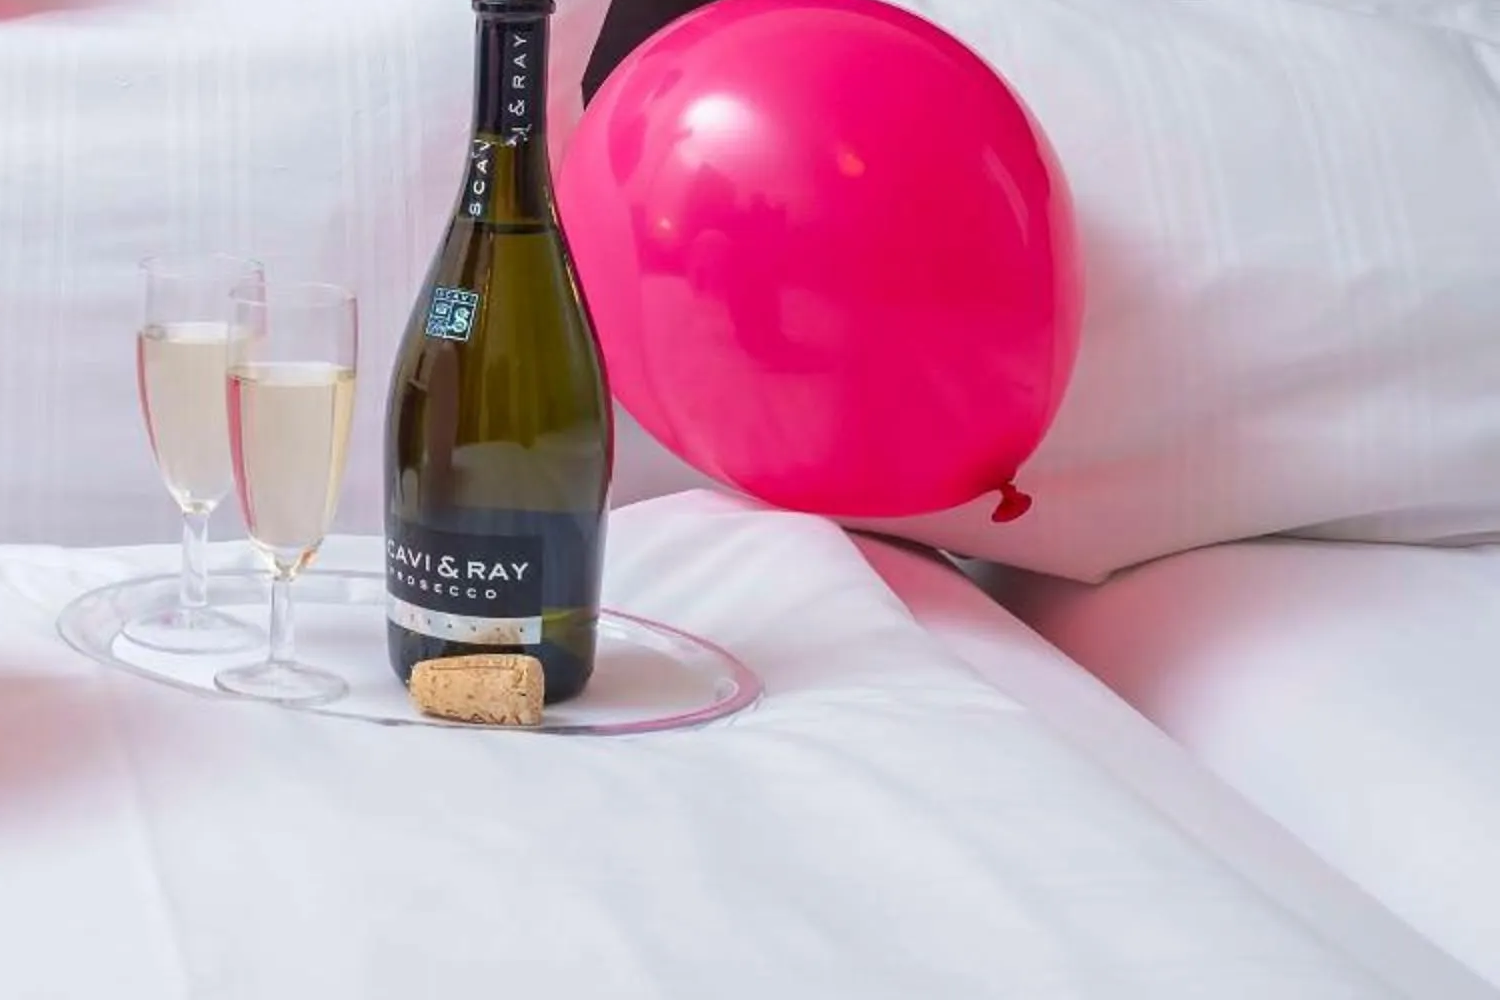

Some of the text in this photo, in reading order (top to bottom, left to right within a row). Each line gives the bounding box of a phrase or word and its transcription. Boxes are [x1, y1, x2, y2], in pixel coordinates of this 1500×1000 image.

[512, 33, 527, 89] RAY
[508, 99, 525, 117] &
[437, 555, 459, 579] &
[467, 561, 529, 581] RAY
